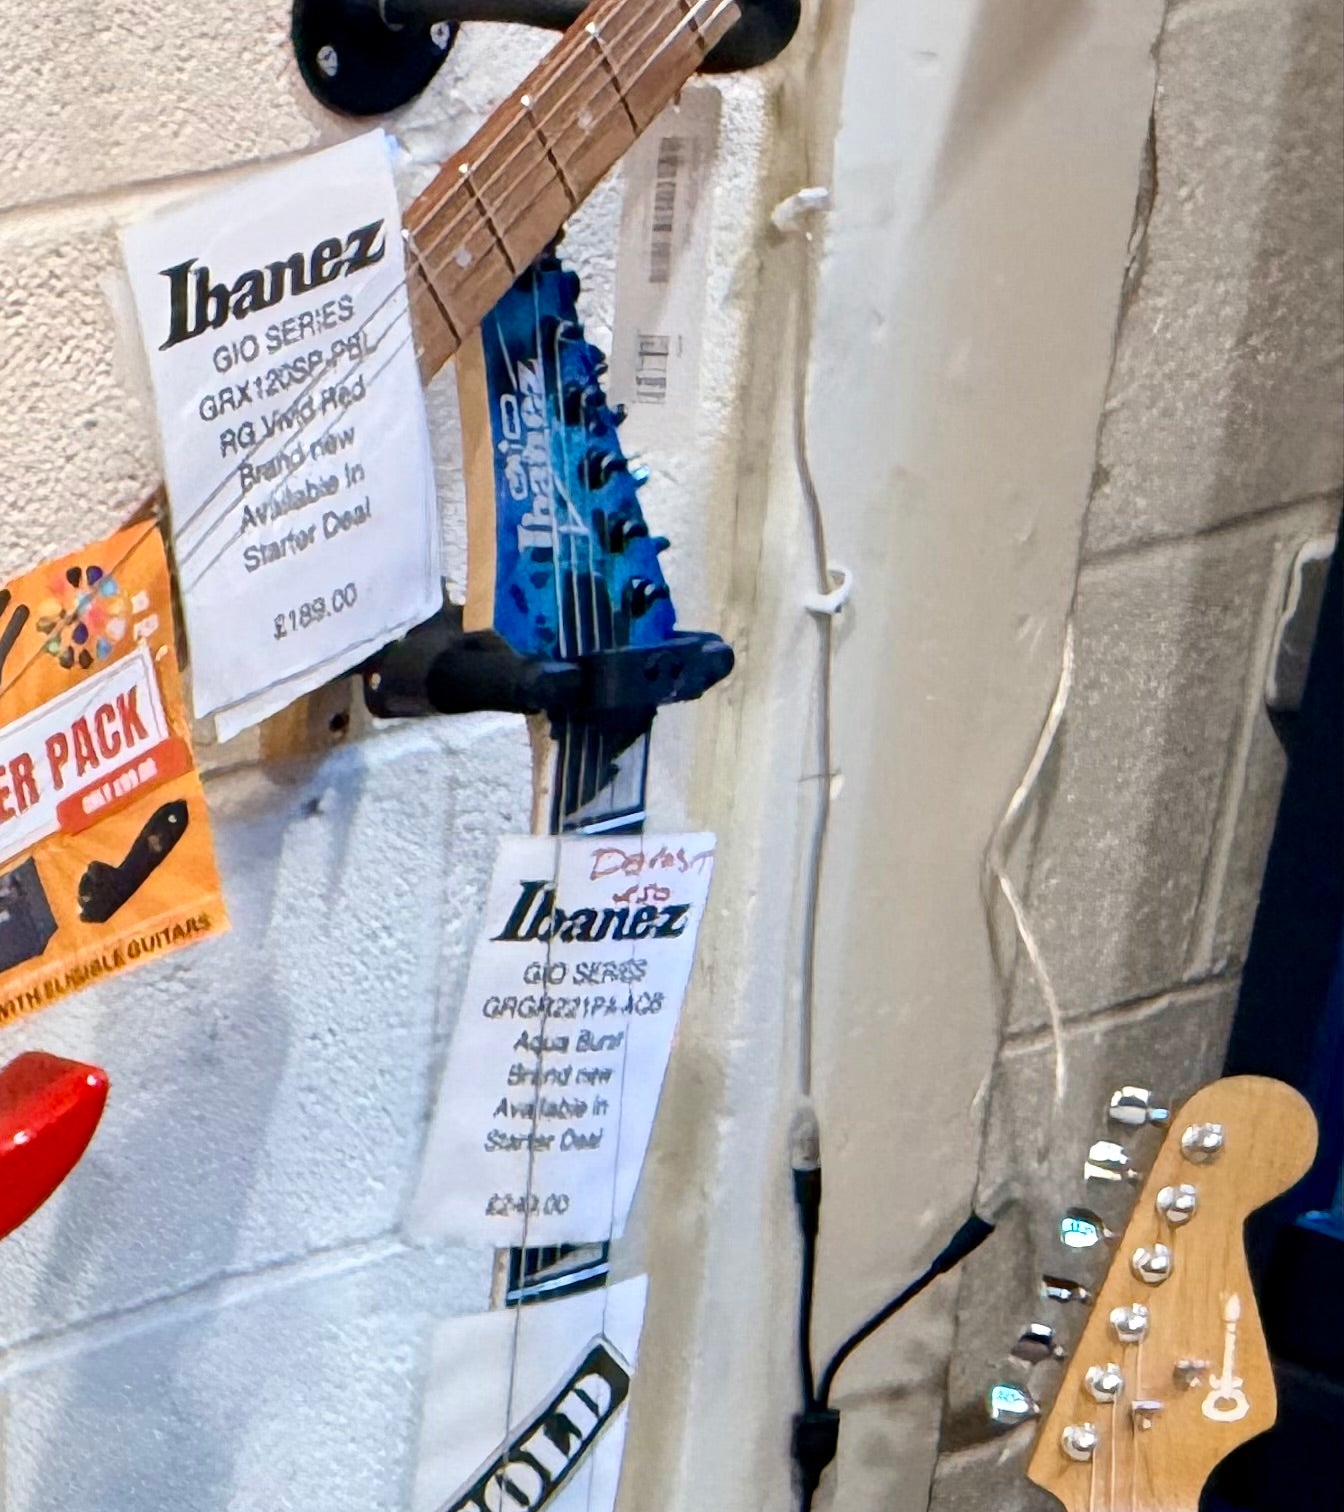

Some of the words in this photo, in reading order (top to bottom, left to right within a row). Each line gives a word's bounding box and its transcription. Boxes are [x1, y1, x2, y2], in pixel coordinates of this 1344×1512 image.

[158, 218, 387, 351] Ibanez
[212, 334, 259, 374] GIO
[265, 294, 355, 349] SERIES
[220, 422, 256, 458] RG
[262, 396, 317, 441] Vivid
[319, 374, 367, 418] Red
[238, 443, 306, 492] Brand
[309, 424, 356, 463] new
[517, 359, 552, 549] Ibanez
[240, 478, 339, 533] Available
[243, 524, 317, 574] Starter
[322, 497, 372, 541] Deal
[272, 582, 358, 642] £189.00
[45, 684, 149, 792] PACK
[127, 912, 212, 959] GUITARS
[490, 879, 691, 943] Ibanez
[524, 961, 567, 985] GIO
[514, 1030, 569, 1055] Aqua
[507, 1066, 573, 1087] Brand
[493, 1097, 588, 1121] Available
[484, 1129, 555, 1153] Starter
